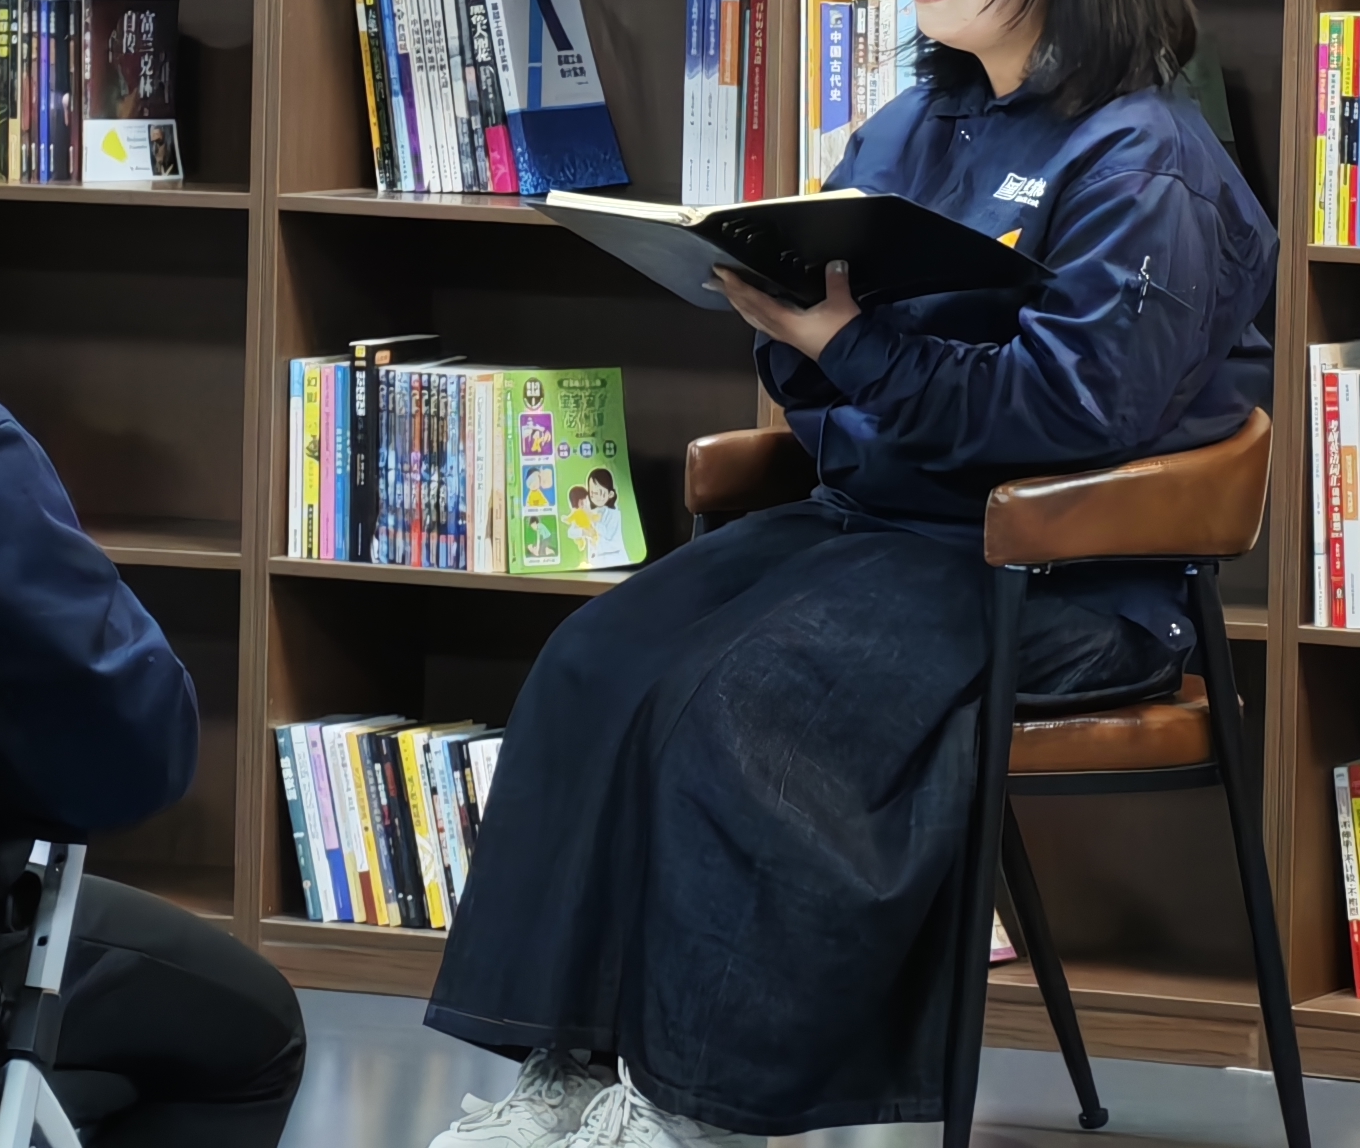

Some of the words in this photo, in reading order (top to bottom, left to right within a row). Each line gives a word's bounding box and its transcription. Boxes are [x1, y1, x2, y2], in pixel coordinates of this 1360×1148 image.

[829, 31, 842, 102] 中国古代史
